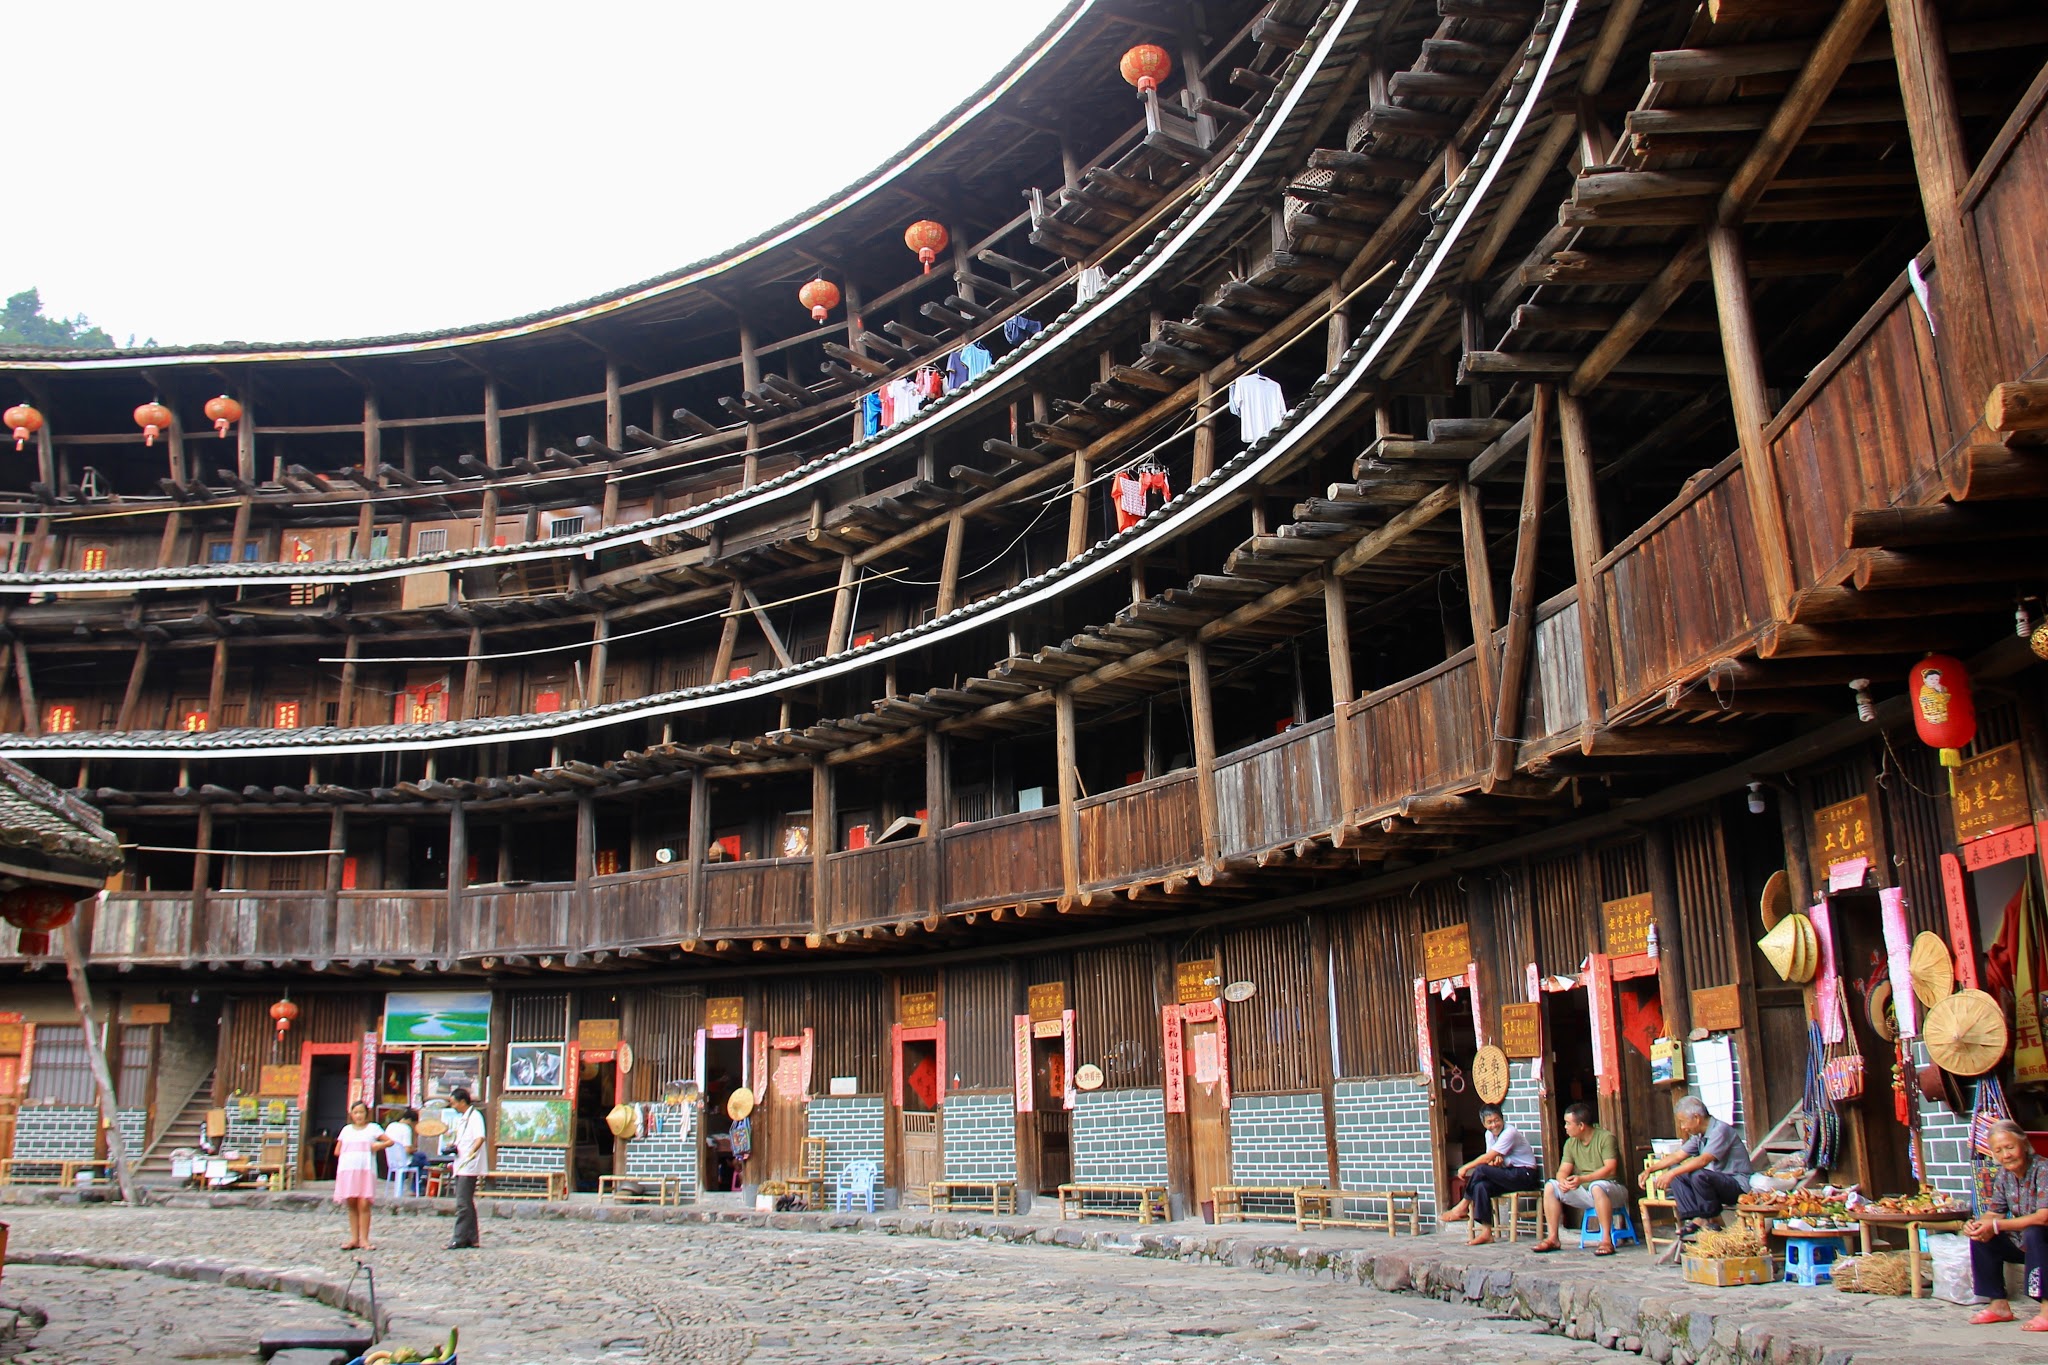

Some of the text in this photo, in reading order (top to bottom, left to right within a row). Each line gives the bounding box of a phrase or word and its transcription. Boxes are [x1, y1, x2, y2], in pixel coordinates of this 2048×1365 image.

[1824, 819, 1865, 852] 工艺品
[710, 1006, 739, 1020] 工艺品
